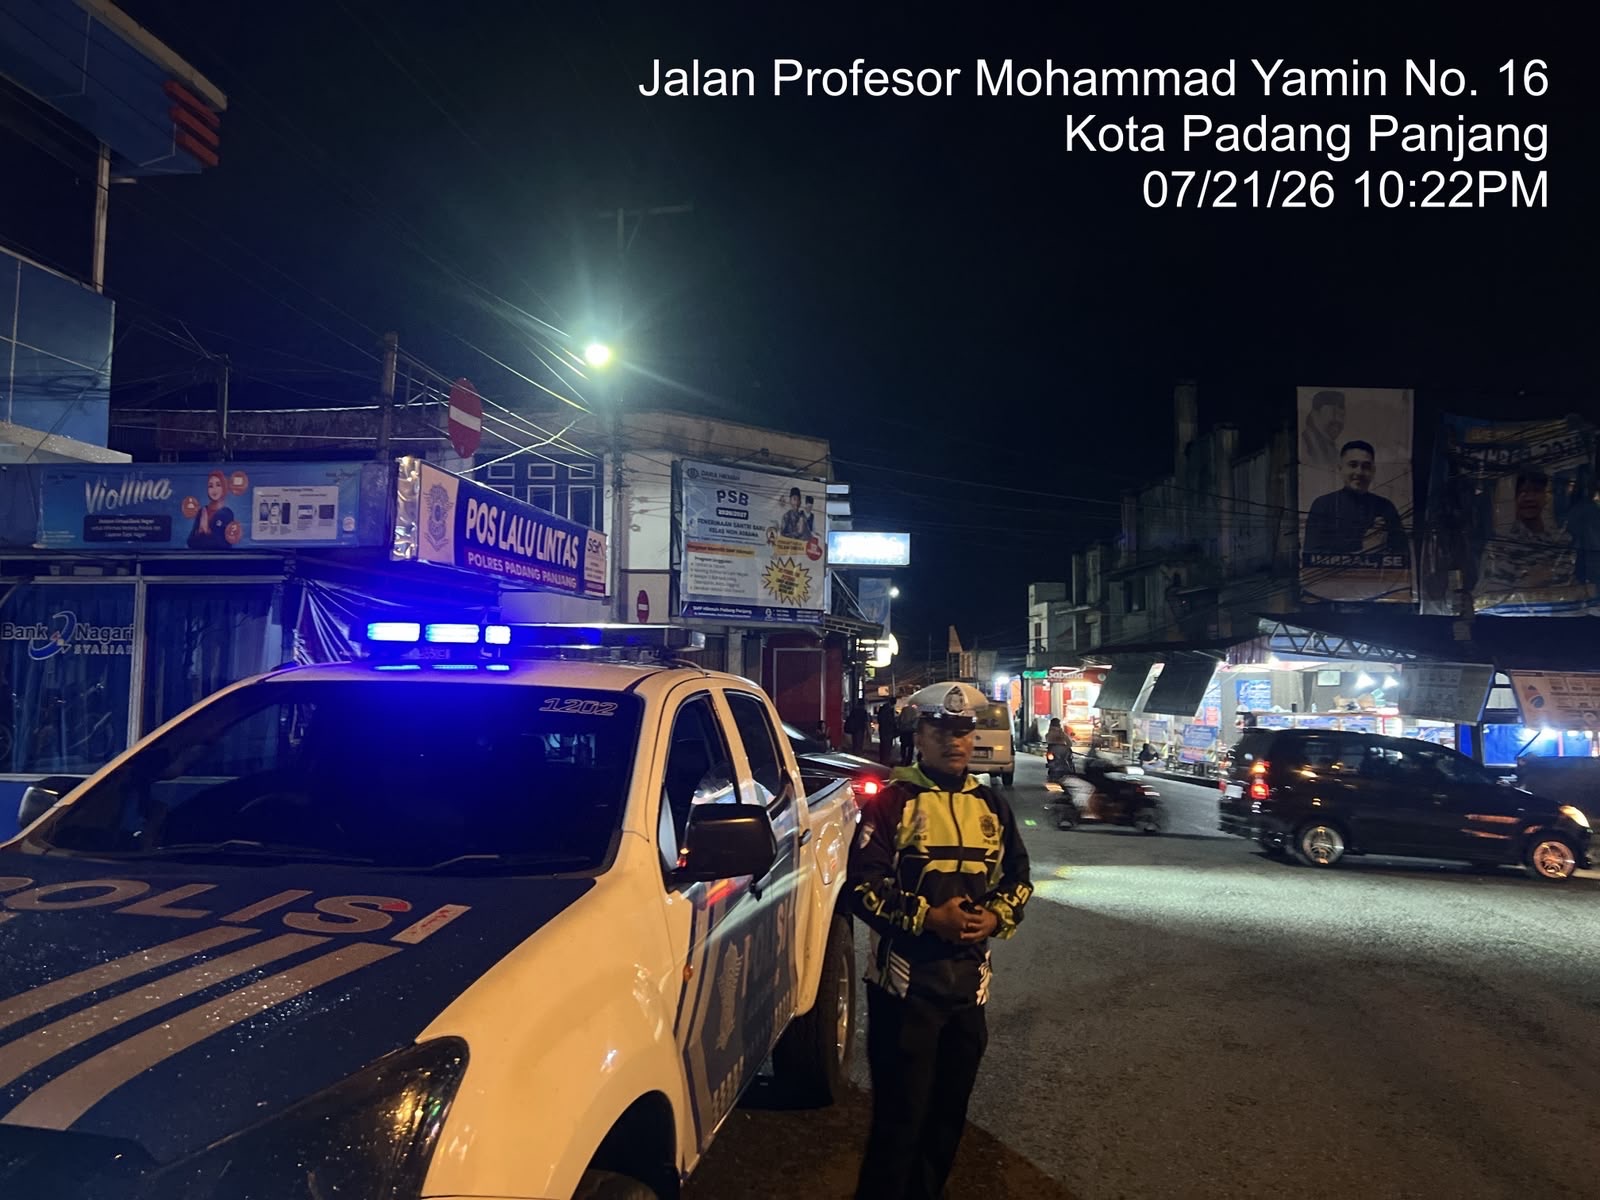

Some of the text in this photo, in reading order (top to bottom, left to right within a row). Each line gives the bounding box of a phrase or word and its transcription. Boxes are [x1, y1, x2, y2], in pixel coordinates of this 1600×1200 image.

[716, 490, 749, 506] PSB
[465, 498, 579, 569] POS LALU LINTAS
[467, 552, 503, 571] POLRES
[505, 561, 541, 580] PADANG
[542, 571, 577, 588] PANJANG
[1383, 556, 1403, 566] SE
[1, 622, 134, 644] Bank Nagari
[538, 698, 618, 716] 1202
[0, 876, 472, 944] OLISI
